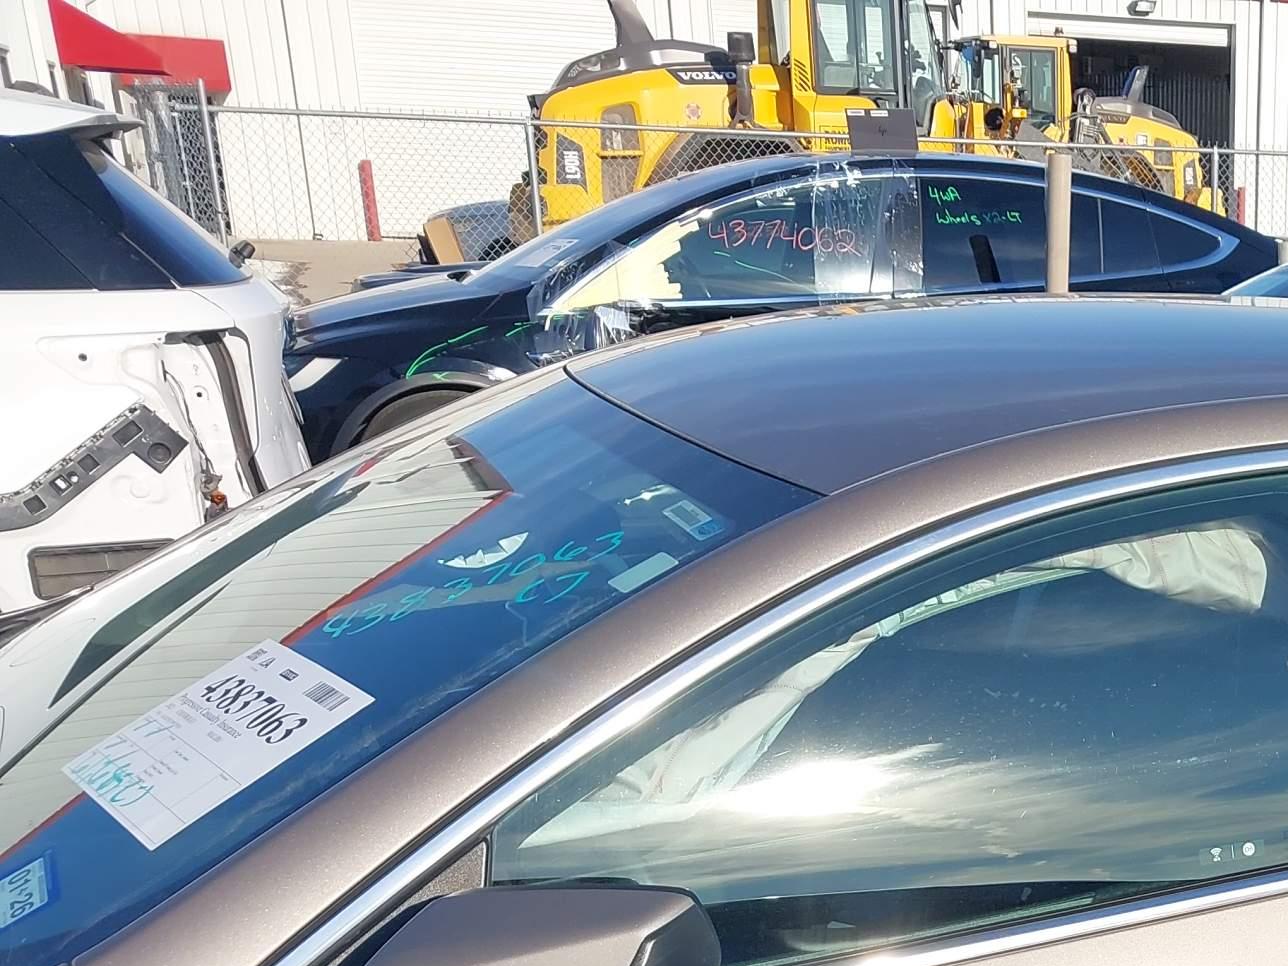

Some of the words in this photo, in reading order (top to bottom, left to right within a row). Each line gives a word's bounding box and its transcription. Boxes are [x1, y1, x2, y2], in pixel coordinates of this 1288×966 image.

[677, 71, 737, 80] VOLVO
[707, 219, 862, 257] 43774062
[200, 674, 309, 745] 43837063
